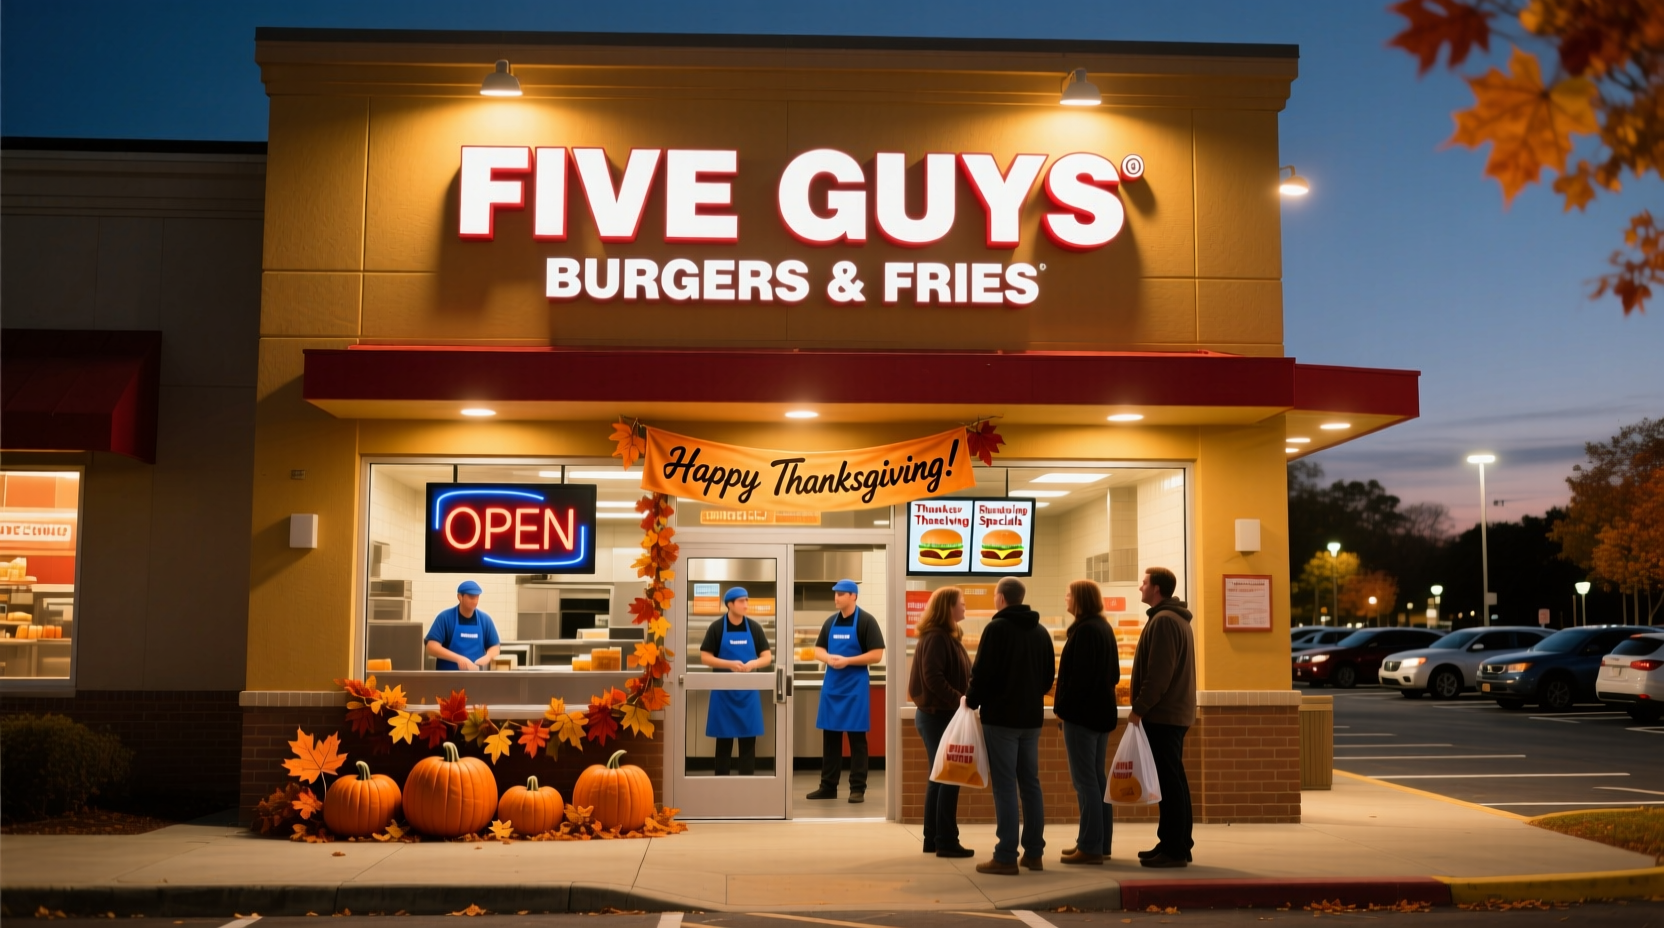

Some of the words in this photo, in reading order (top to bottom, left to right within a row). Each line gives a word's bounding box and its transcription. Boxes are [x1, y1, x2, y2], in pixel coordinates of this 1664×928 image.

[459, 145, 738, 241] FIVE
[544, 257, 809, 302] BURGERS
[828, 261, 866, 302] &
[883, 262, 1040, 305] FRIES
[663, 445, 761, 503] Happy
[770, 438, 959, 503] Thanksgiving!
[445, 507, 574, 550] OPEN
